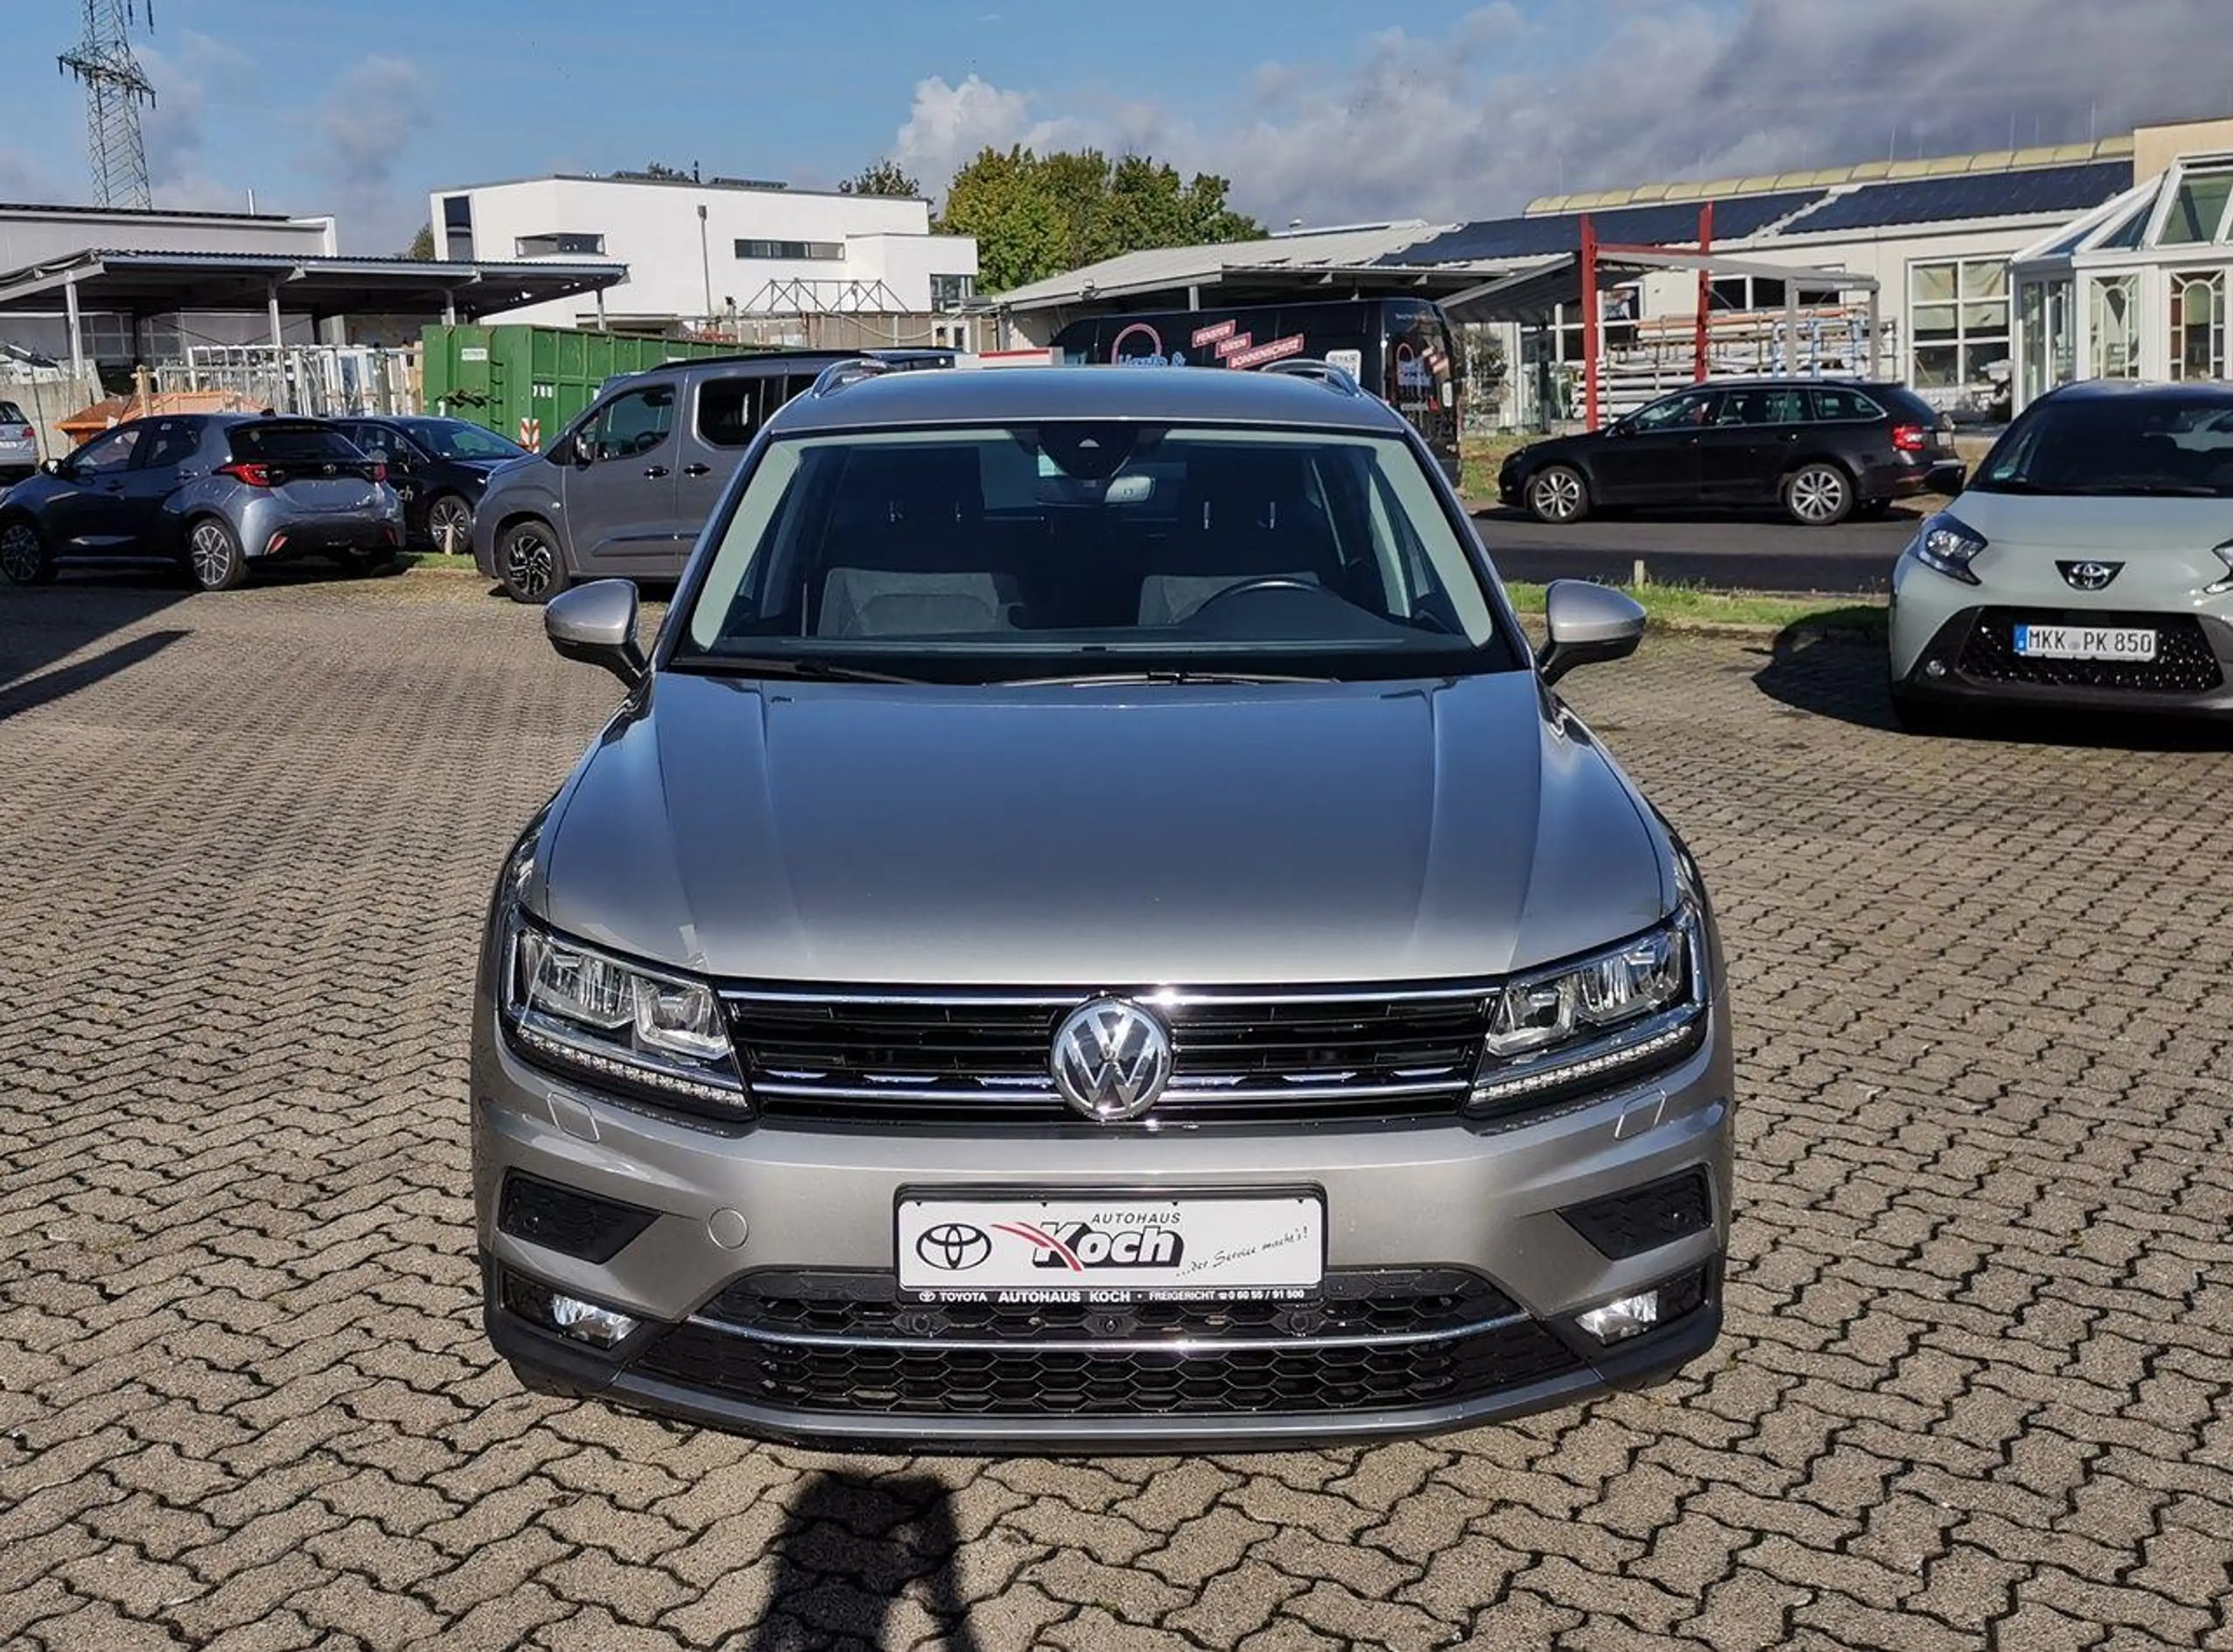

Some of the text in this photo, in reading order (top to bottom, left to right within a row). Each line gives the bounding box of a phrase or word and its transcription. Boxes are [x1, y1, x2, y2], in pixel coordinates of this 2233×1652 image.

[2029, 629, 2152, 653] MKK PK 850
[1091, 1212, 1182, 1224] AUTOHAUS
[1033, 1222, 1185, 1268] Koch
[940, 1293, 987, 1303] TOYOTA
[998, 1292, 1081, 1303] AUTOHAUS
[1090, 1291, 1130, 1303] KOCH
[1149, 1291, 1215, 1300] FREIGERICHT
